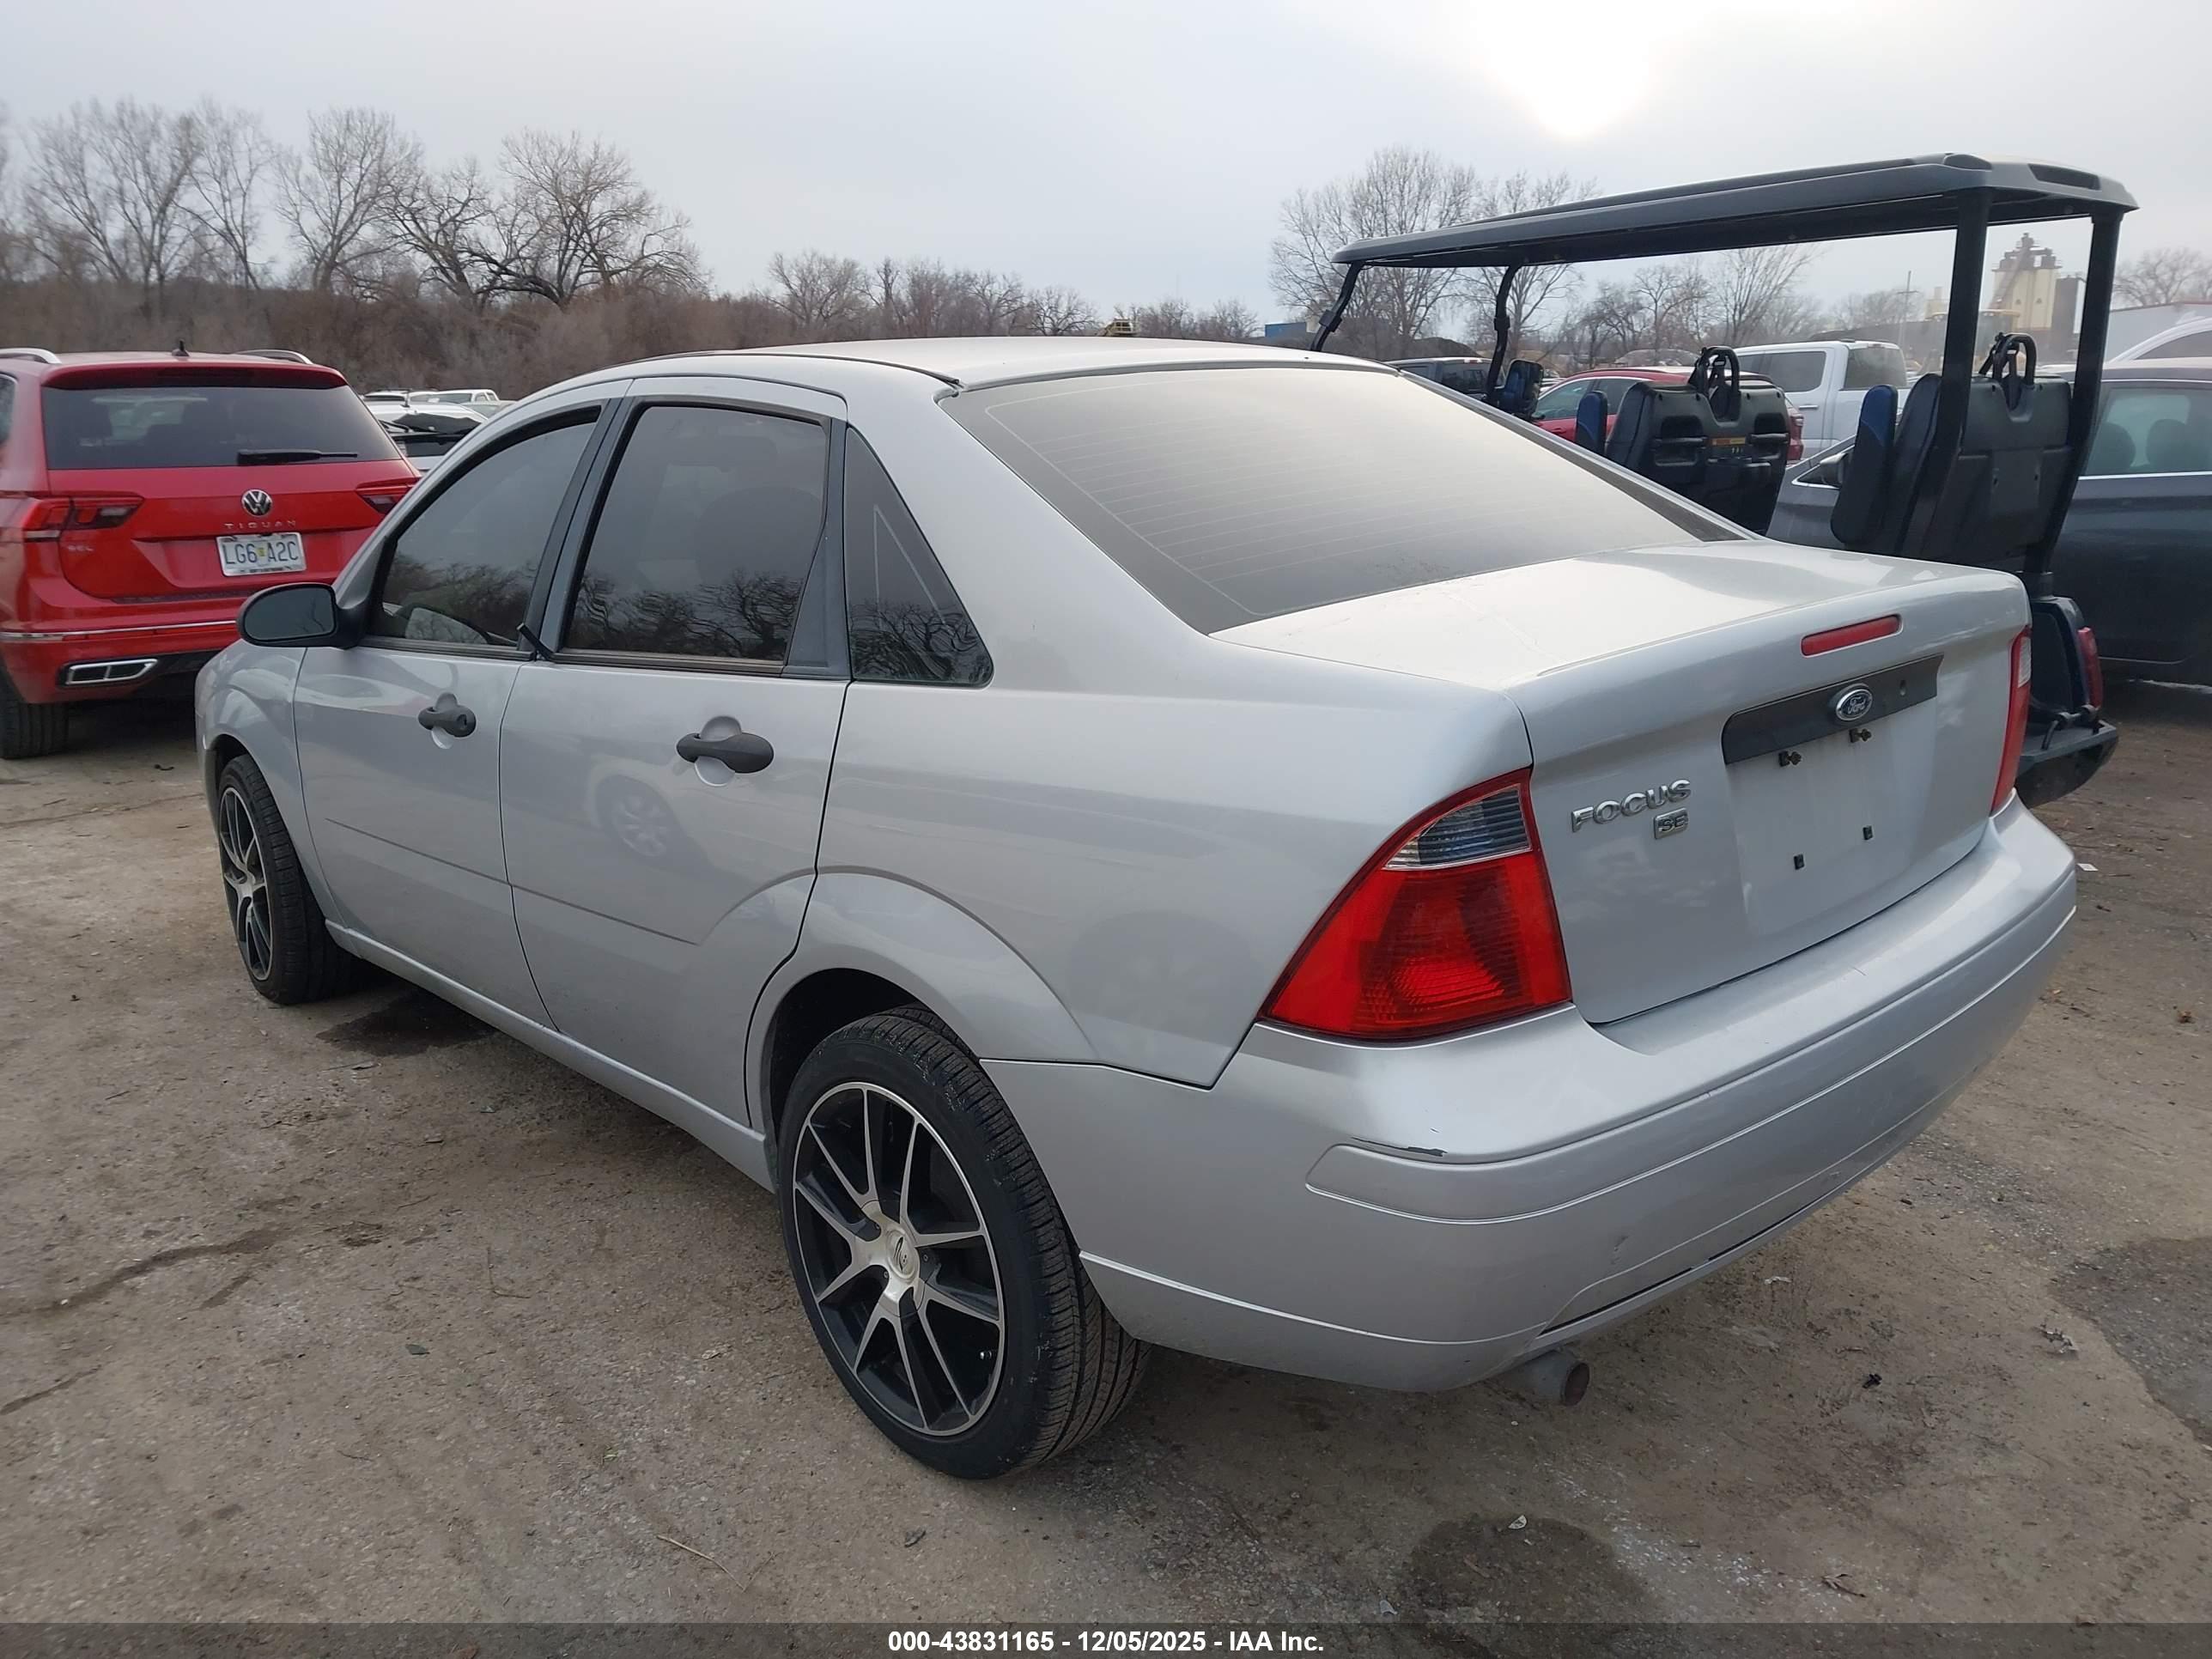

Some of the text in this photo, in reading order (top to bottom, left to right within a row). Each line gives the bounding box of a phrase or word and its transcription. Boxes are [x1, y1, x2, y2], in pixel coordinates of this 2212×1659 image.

[224, 520, 296, 529] TIGUAN
[222, 541, 298, 564] LG6 A2C
[1571, 779, 1691, 832] FOCUS
